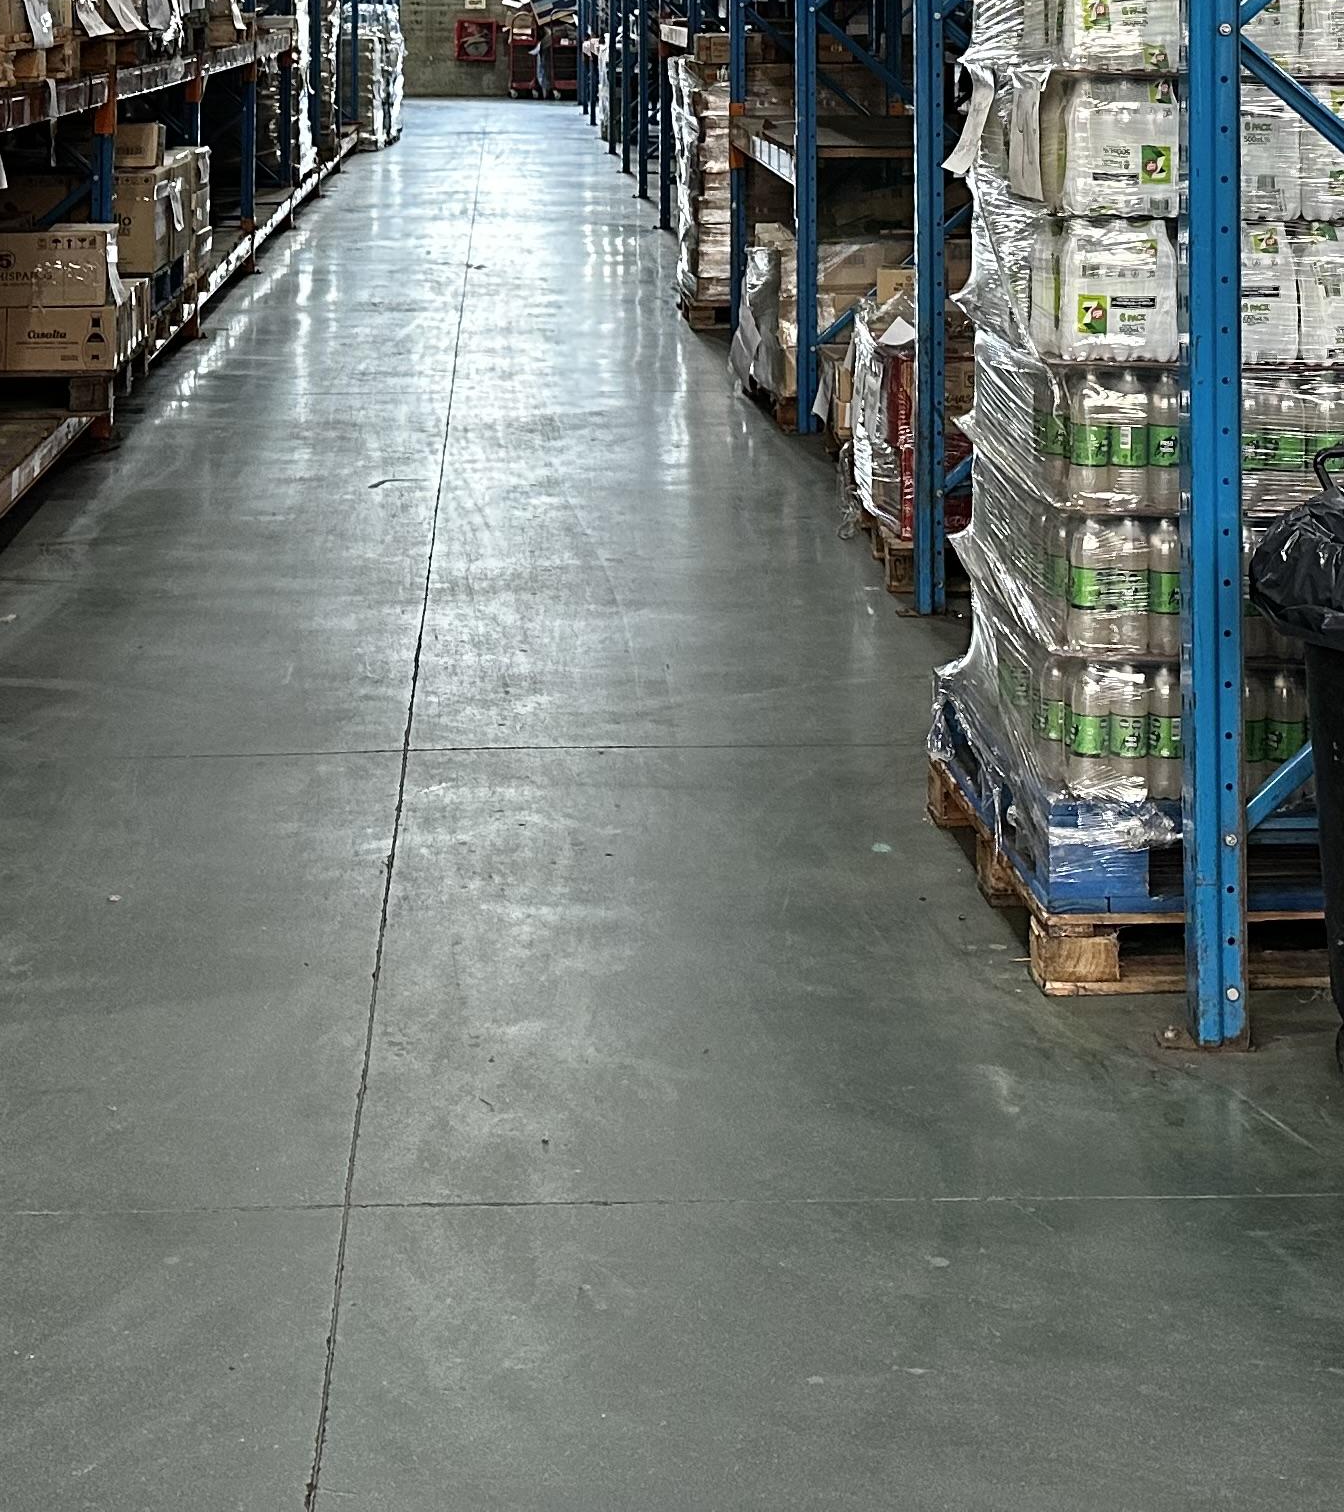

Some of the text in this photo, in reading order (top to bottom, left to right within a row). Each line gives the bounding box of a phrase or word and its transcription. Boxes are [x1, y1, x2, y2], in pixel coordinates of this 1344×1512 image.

[0, 254, 12, 268] 5
[1129, 313, 1146, 321] PACK
[27, 329, 66, 340] Casalta
